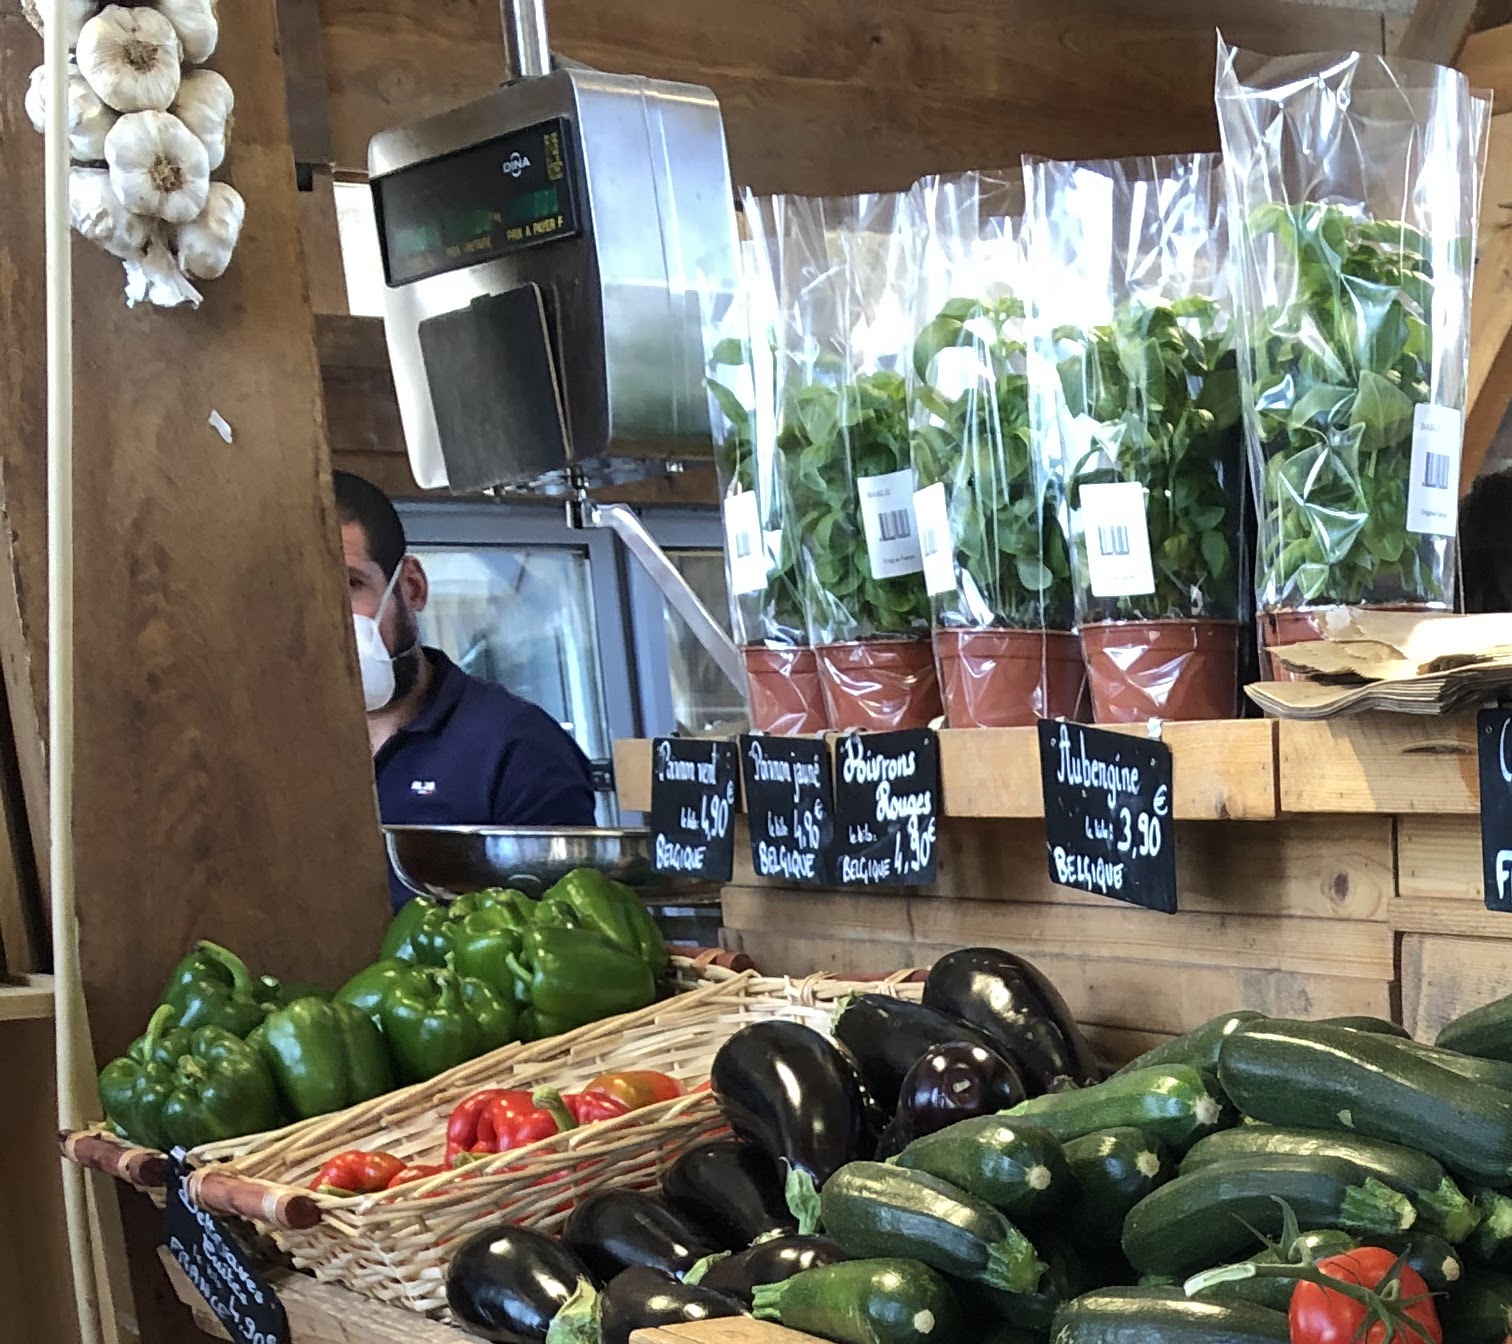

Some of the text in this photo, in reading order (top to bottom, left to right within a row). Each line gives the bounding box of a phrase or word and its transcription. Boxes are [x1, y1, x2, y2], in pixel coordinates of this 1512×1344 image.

[843, 735, 916, 784] Poivrons
[1057, 724, 1142, 810] Aubergine
[656, 833, 706, 871] BELGIQUE
[759, 841, 816, 879] BELGIQUE
[842, 855, 891, 885] BELGIQUE
[1053, 846, 1124, 894] BELGIQUE
